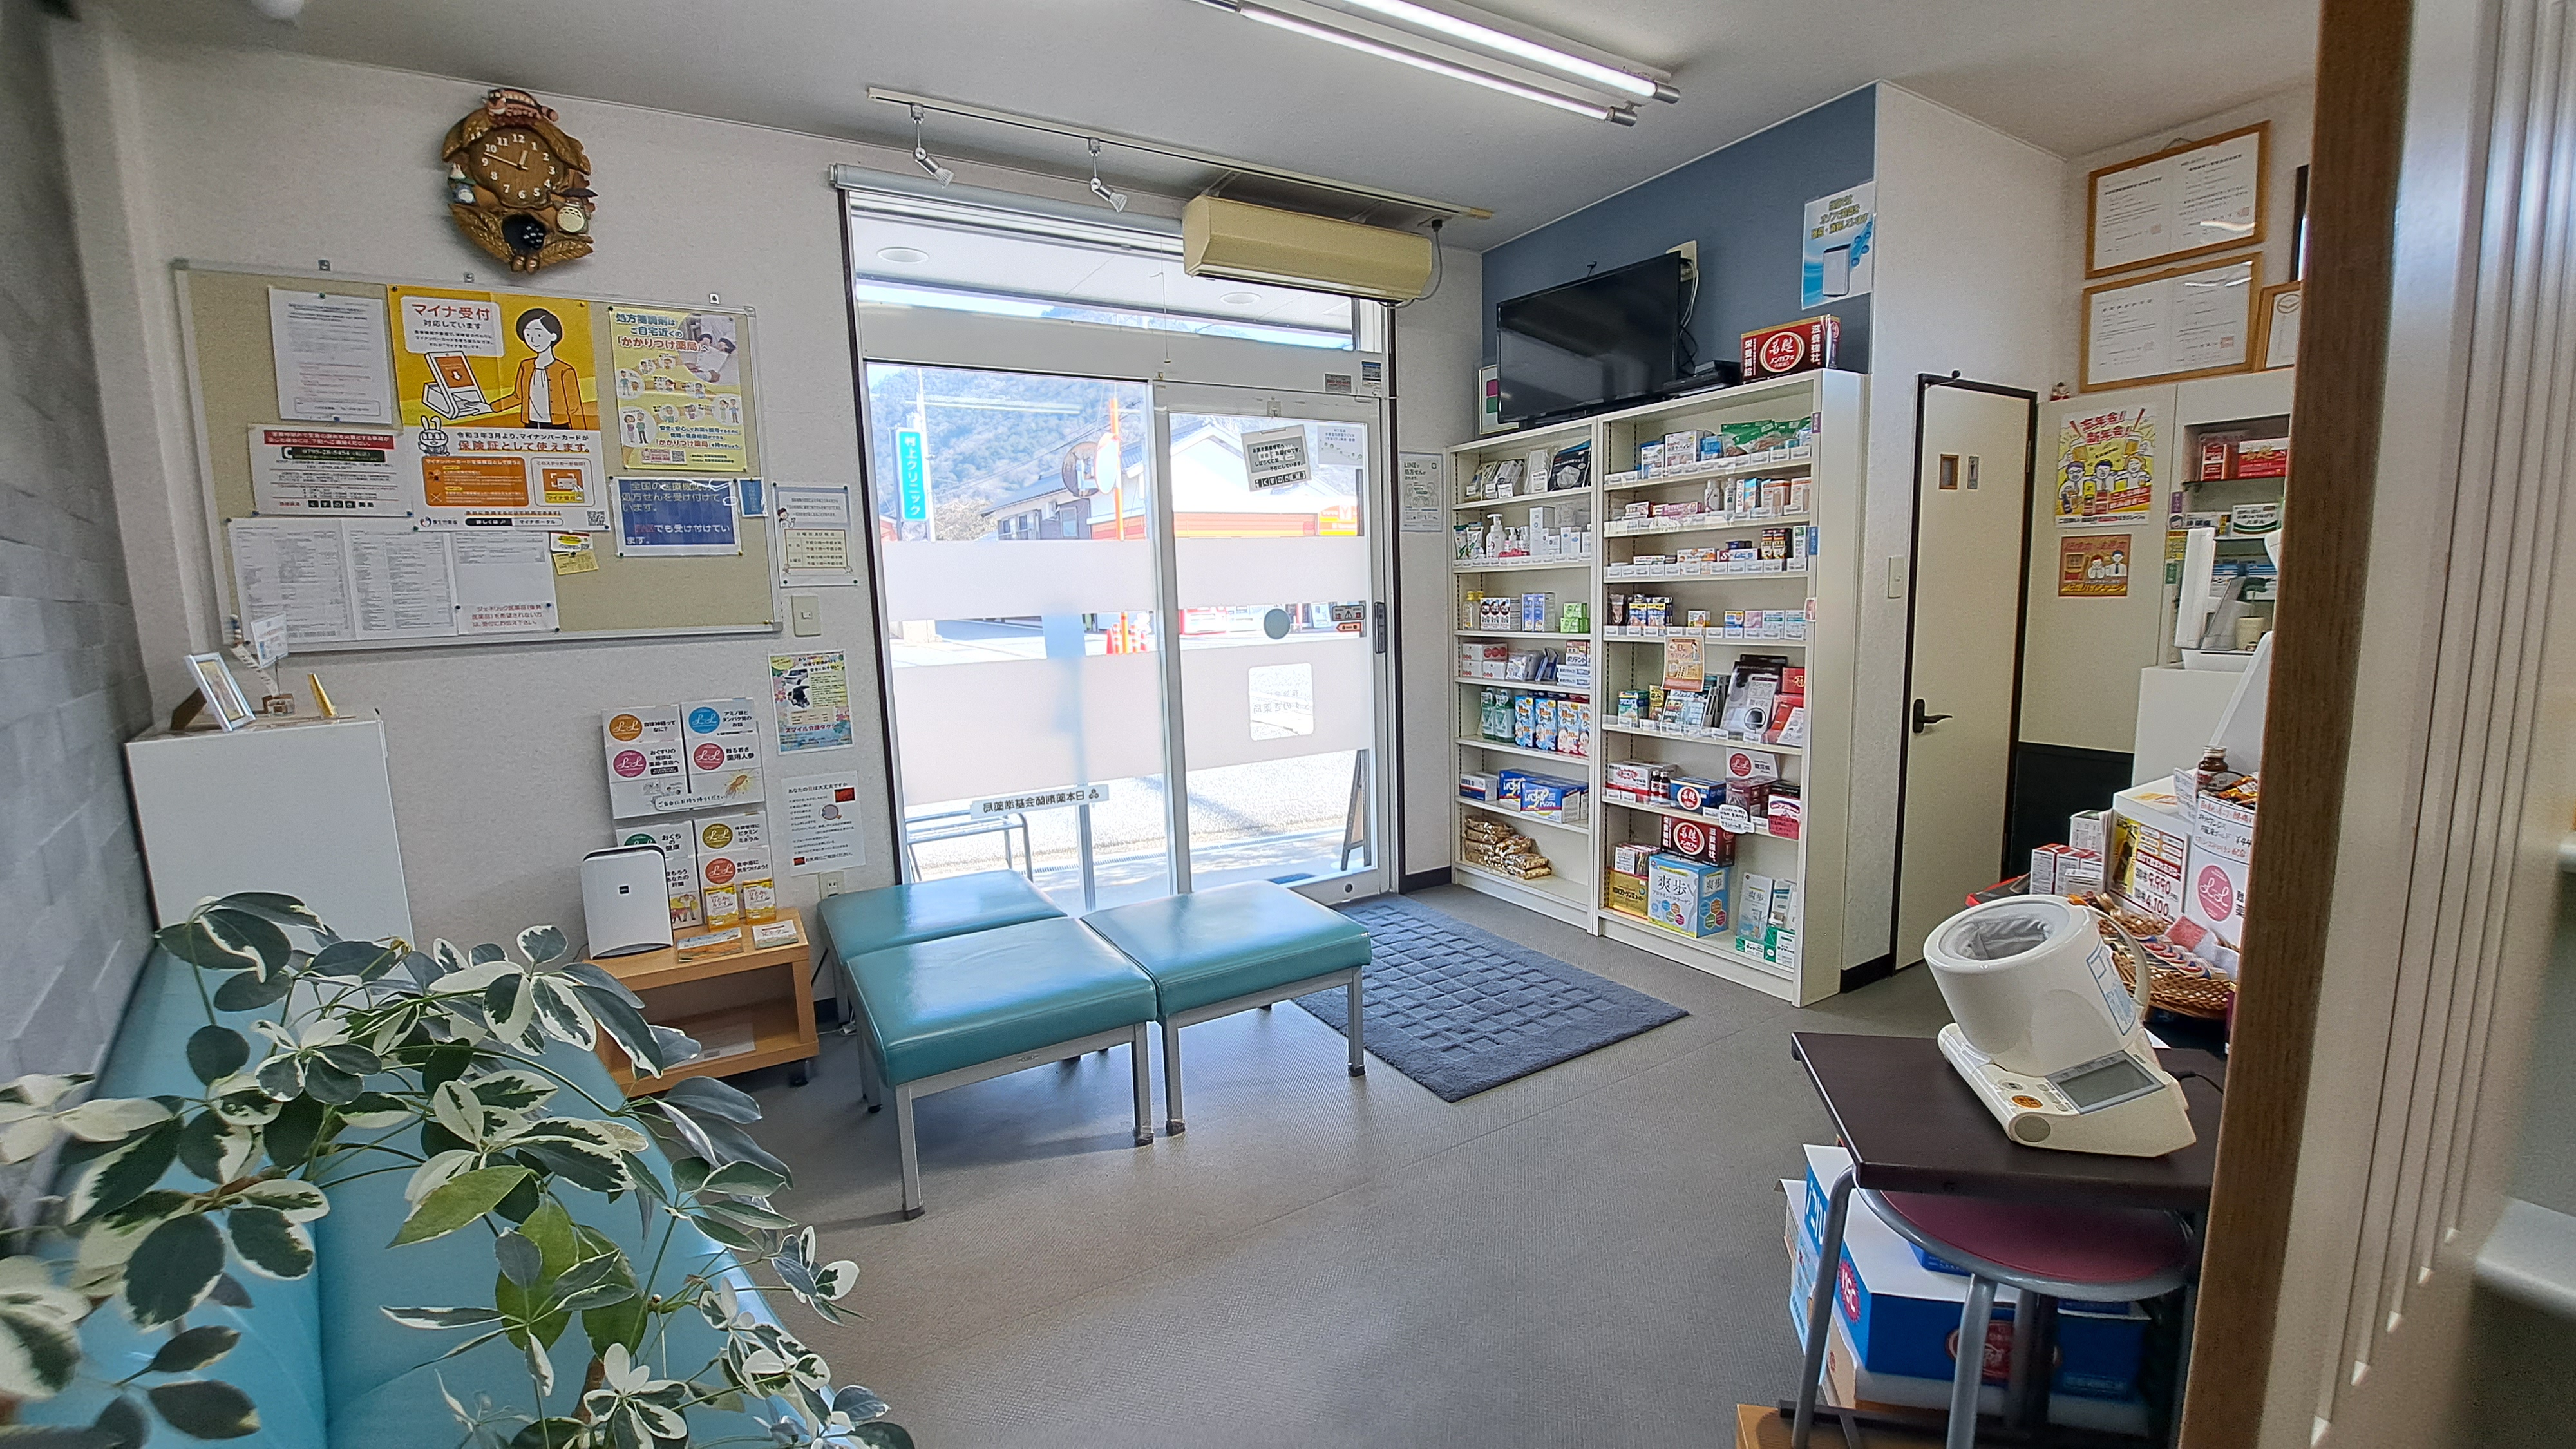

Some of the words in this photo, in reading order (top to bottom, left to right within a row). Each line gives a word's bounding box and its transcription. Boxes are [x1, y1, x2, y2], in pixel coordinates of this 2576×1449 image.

[497, 137, 509, 146] 11
[513, 134, 525, 143] 12
[485, 144, 497, 153] 10
[531, 142, 537, 151] 1
[543, 153, 549, 161] 2
[482, 158, 489, 166] 9
[549, 166, 556, 175] 3
[491, 172, 498, 180] 8
[544, 179, 551, 188] 4
[504, 184, 510, 193] 7
[533, 188, 540, 197] 5
[518, 190, 526, 198] 6
[412, 304, 490, 321] マイナ受付
[423, 319, 482, 330] 対応しています
[630, 327, 683, 338] ご自宅近くの
[618, 336, 709, 352] 「かかりつけ薬局」へ
[1770, 355, 1795, 365] ノンカフェ
[458, 440, 590, 453] 保険証として使えます。
[904, 435, 921, 516] 村上クリニック
[622, 493, 721, 502] 処方せんを受け付けて
[623, 503, 658, 512] います。
[635, 524, 730, 533] FAXでも受け付けてい
[627, 536, 650, 545] ます。
[726, 752, 755, 761] 薬用人参
[788, 782, 848, 793] あなたの目は大丈夫ですか
[737, 864, 768, 874] 気をつけよう!
[1658, 873, 1687, 895] 爽歩
